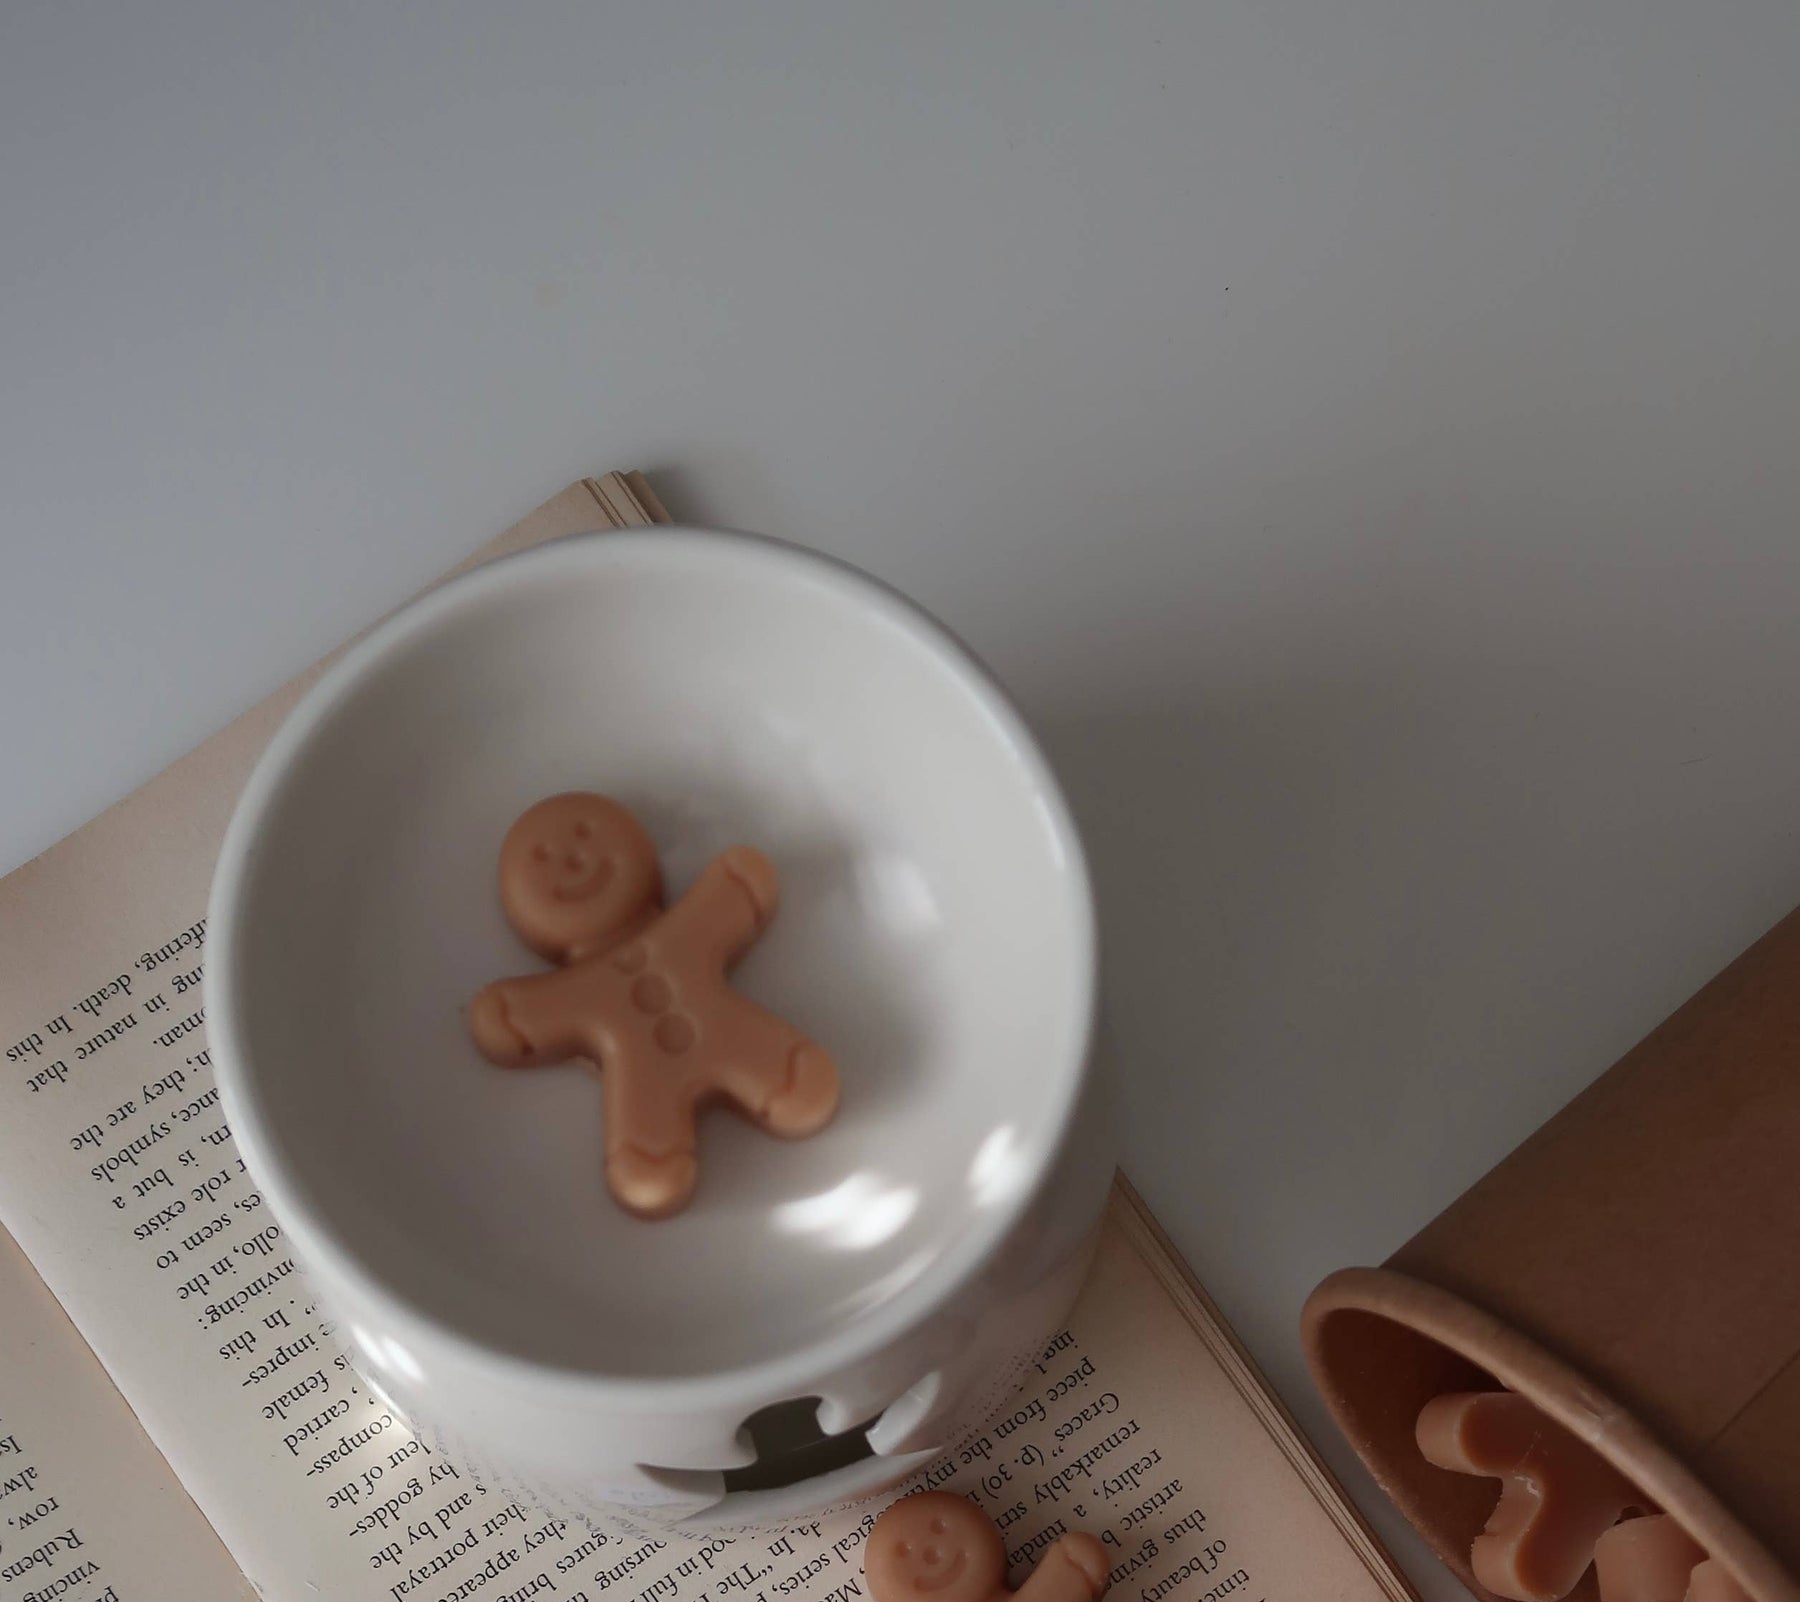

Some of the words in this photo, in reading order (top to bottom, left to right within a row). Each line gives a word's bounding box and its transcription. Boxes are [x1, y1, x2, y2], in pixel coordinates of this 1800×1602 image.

[71, 972, 133, 1018] death.
[141, 991, 171, 1014] in
[43, 1013, 75, 1035] In
[72, 1011, 139, 1061] nature
[4, 1031, 44, 1063] this
[24, 1058, 69, 1093] that
[141, 1068, 186, 1106] they
[104, 1099, 138, 1128] are
[68, 1122, 105, 1152] the
[89, 1120, 172, 1184] symbols
[176, 1147, 200, 1168] is
[130, 1166, 175, 1198] but
[189, 1167, 232, 1204] role
[110, 1194, 127, 1210] a
[131, 1198, 187, 1241] exists
[179, 1211, 233, 1252] seem
[154, 1248, 180, 1270] to
[208, 1254, 238, 1277] in
[175, 1271, 211, 1301] the
[260, 1307, 292, 1330] In
[217, 1329, 257, 1361] this
[260, 1367, 330, 1421] female
[1044, 1354, 1097, 1403] piece
[281, 1397, 351, 1458] carried
[991, 1396, 1048, 1440] from
[957, 1435, 994, 1465] the
[1032, 1417, 1142, 1505] remarkably
[358, 1464, 384, 1497] of
[1091, 1447, 1163, 1508] reality,
[324, 1481, 361, 1510] the
[432, 1491, 473, 1532] and
[1071, 1502, 1088, 1519] a
[1118, 1477, 1184, 1532] artistic
[6, 1495, 61, 1531] row,
[1161, 1507, 1207, 1545] thus
[405, 1519, 439, 1546] by
[765, 1530, 796, 1555] In
[0, 1526, 85, 1583] Rubens
[368, 1540, 404, 1570] the
[673, 1555, 703, 1578] in
[1201, 1538, 1228, 1571] of
[770, 1551, 831, 1596] series,
